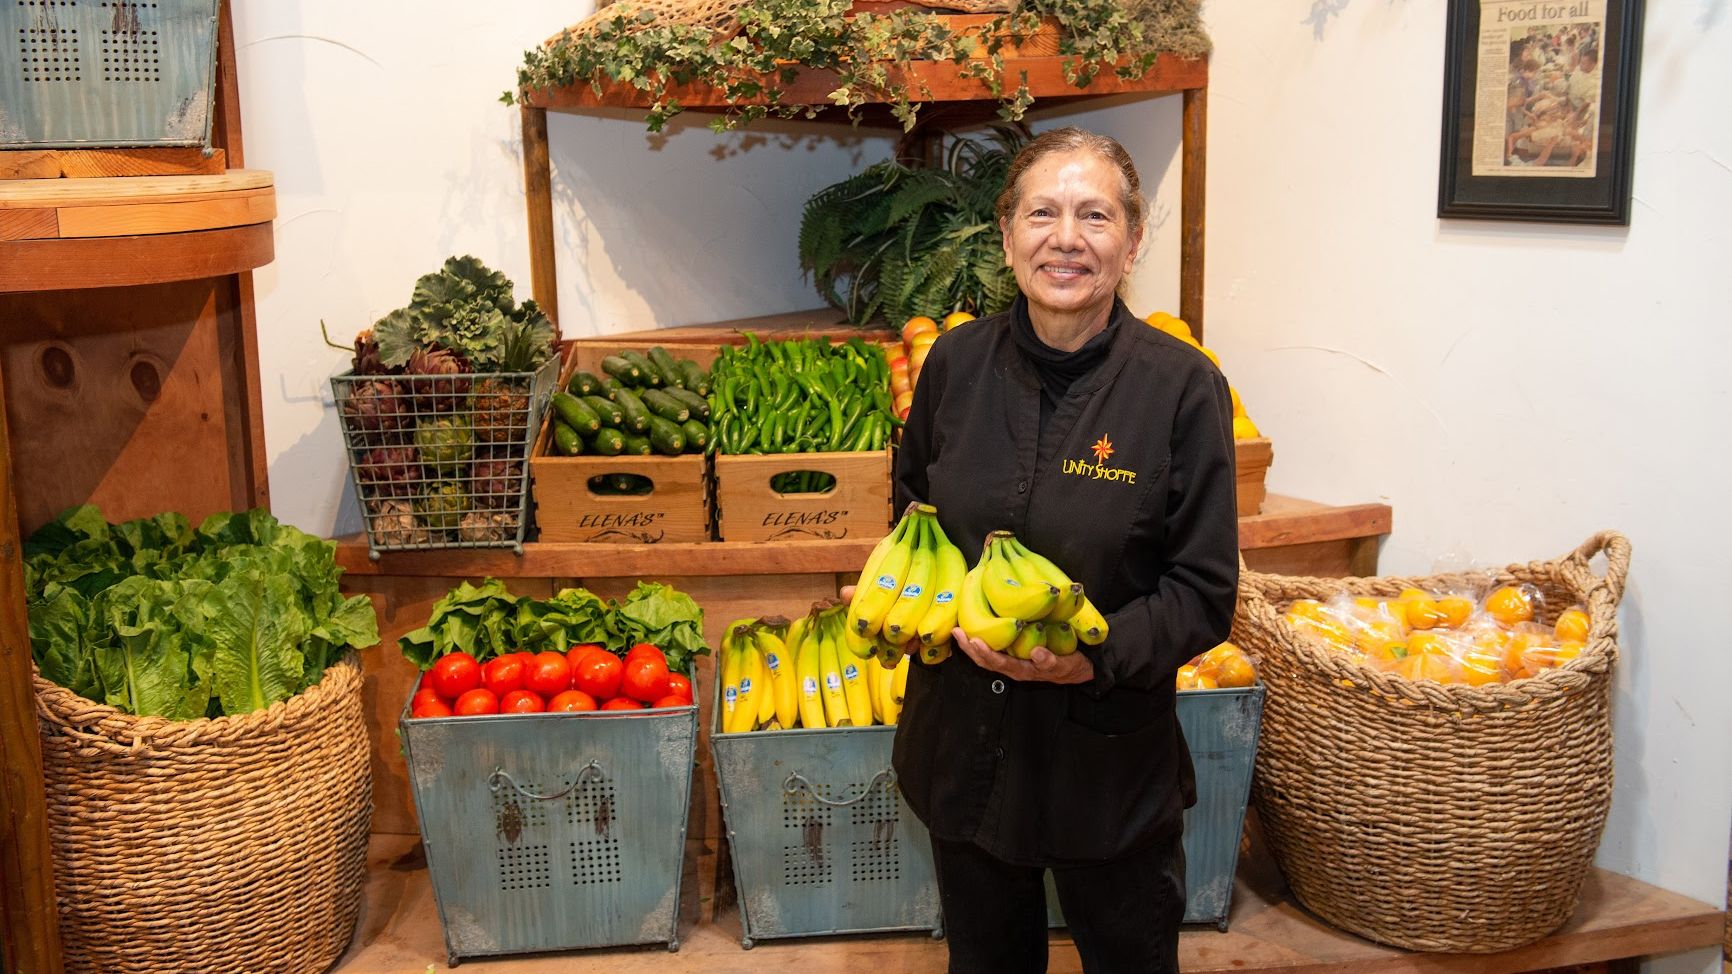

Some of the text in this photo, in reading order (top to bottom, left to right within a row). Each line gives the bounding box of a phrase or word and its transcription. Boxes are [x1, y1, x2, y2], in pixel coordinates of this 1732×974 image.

[1497, 1, 1589, 22] Food for all
[1092, 463, 1137, 484] SHOPPE
